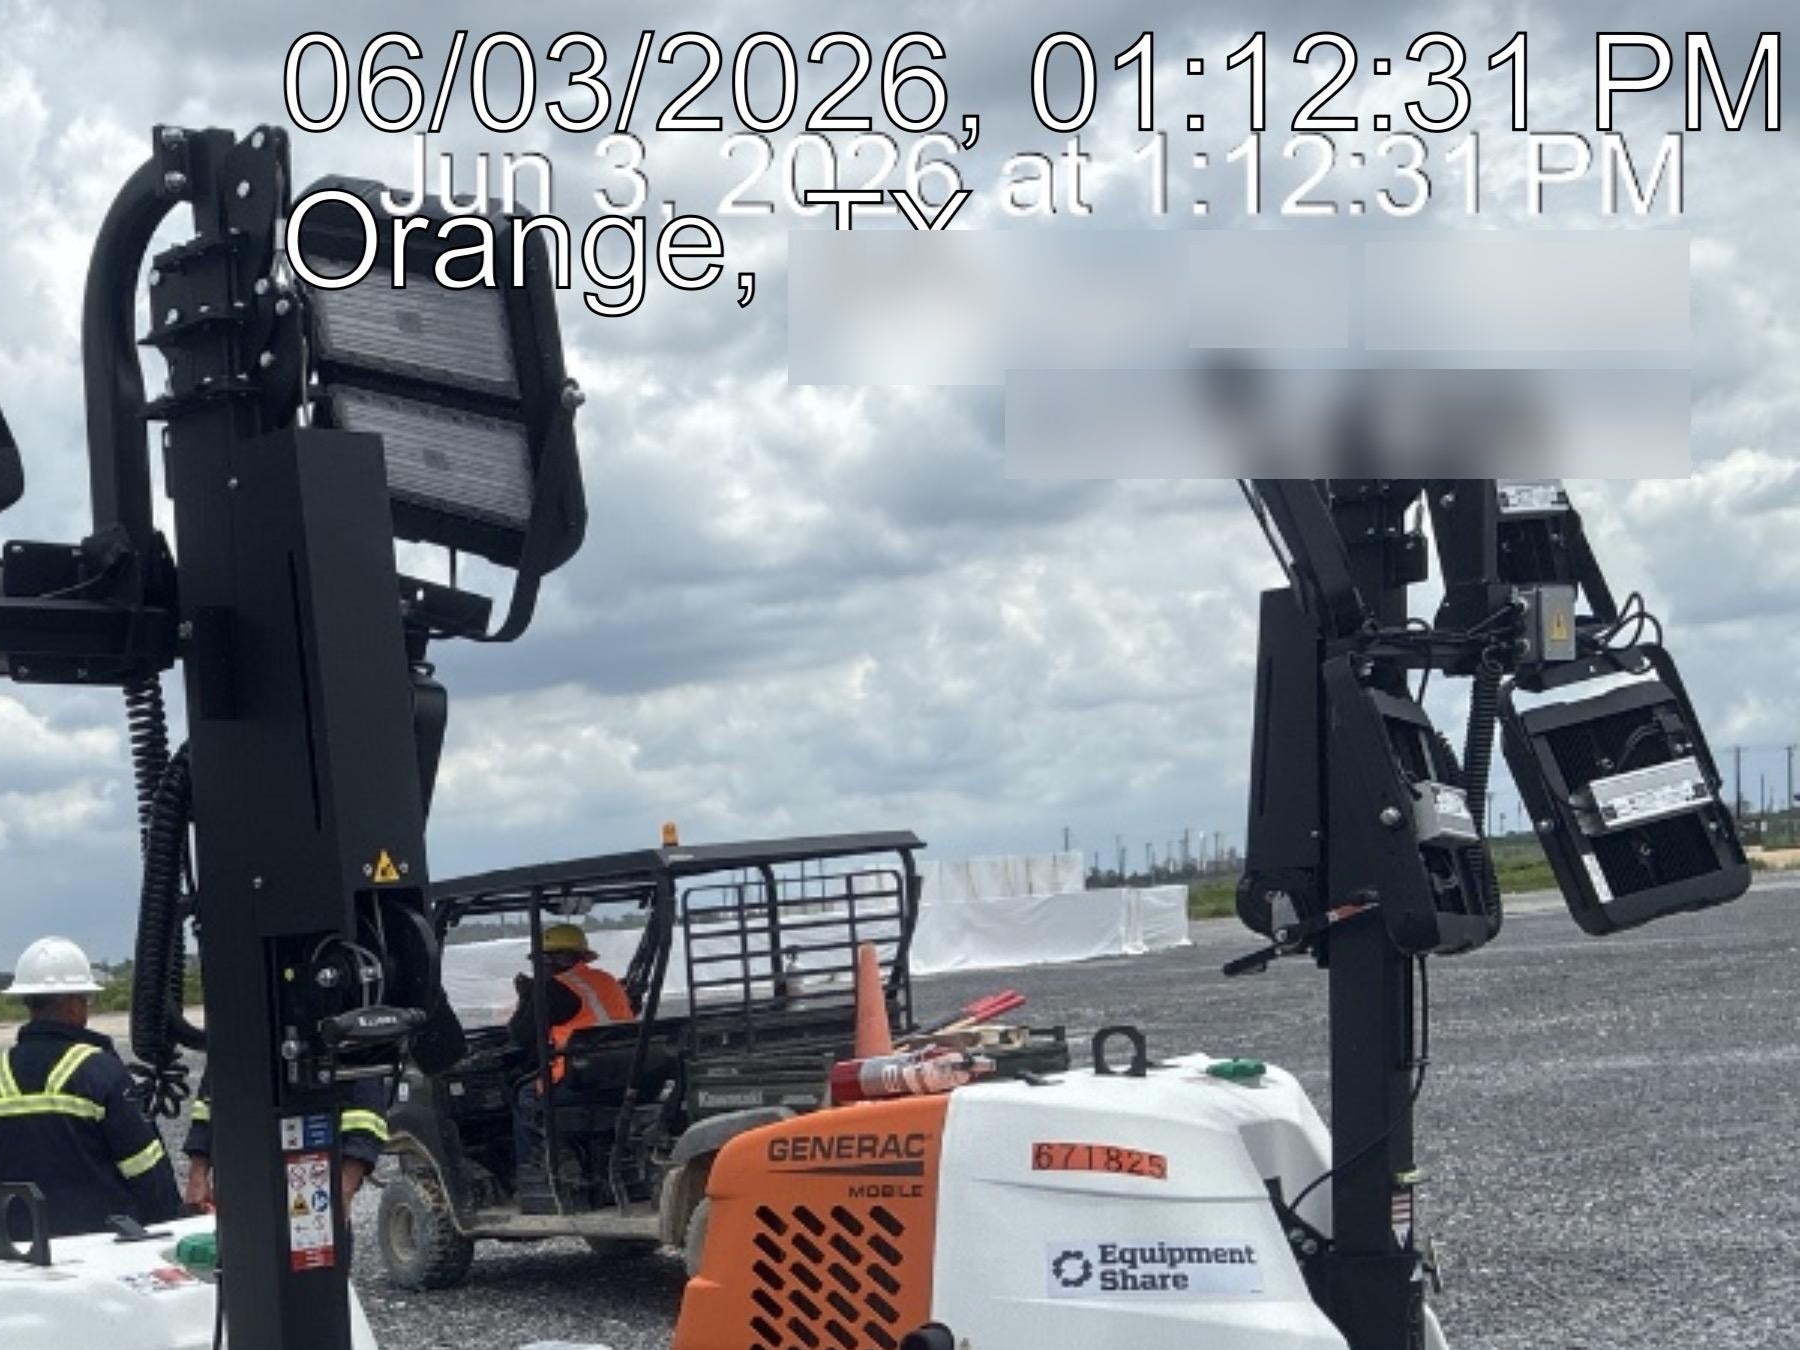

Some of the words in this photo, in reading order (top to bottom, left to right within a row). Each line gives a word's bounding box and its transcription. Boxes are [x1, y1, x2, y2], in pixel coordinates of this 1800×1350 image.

[767, 1133, 925, 1162] GENERAC
[1035, 1142, 1167, 1179] 671825
[849, 1184, 925, 1198] MOBILE
[1098, 1242, 1258, 1268] Equipment
[1100, 1268, 1190, 1291] Share
